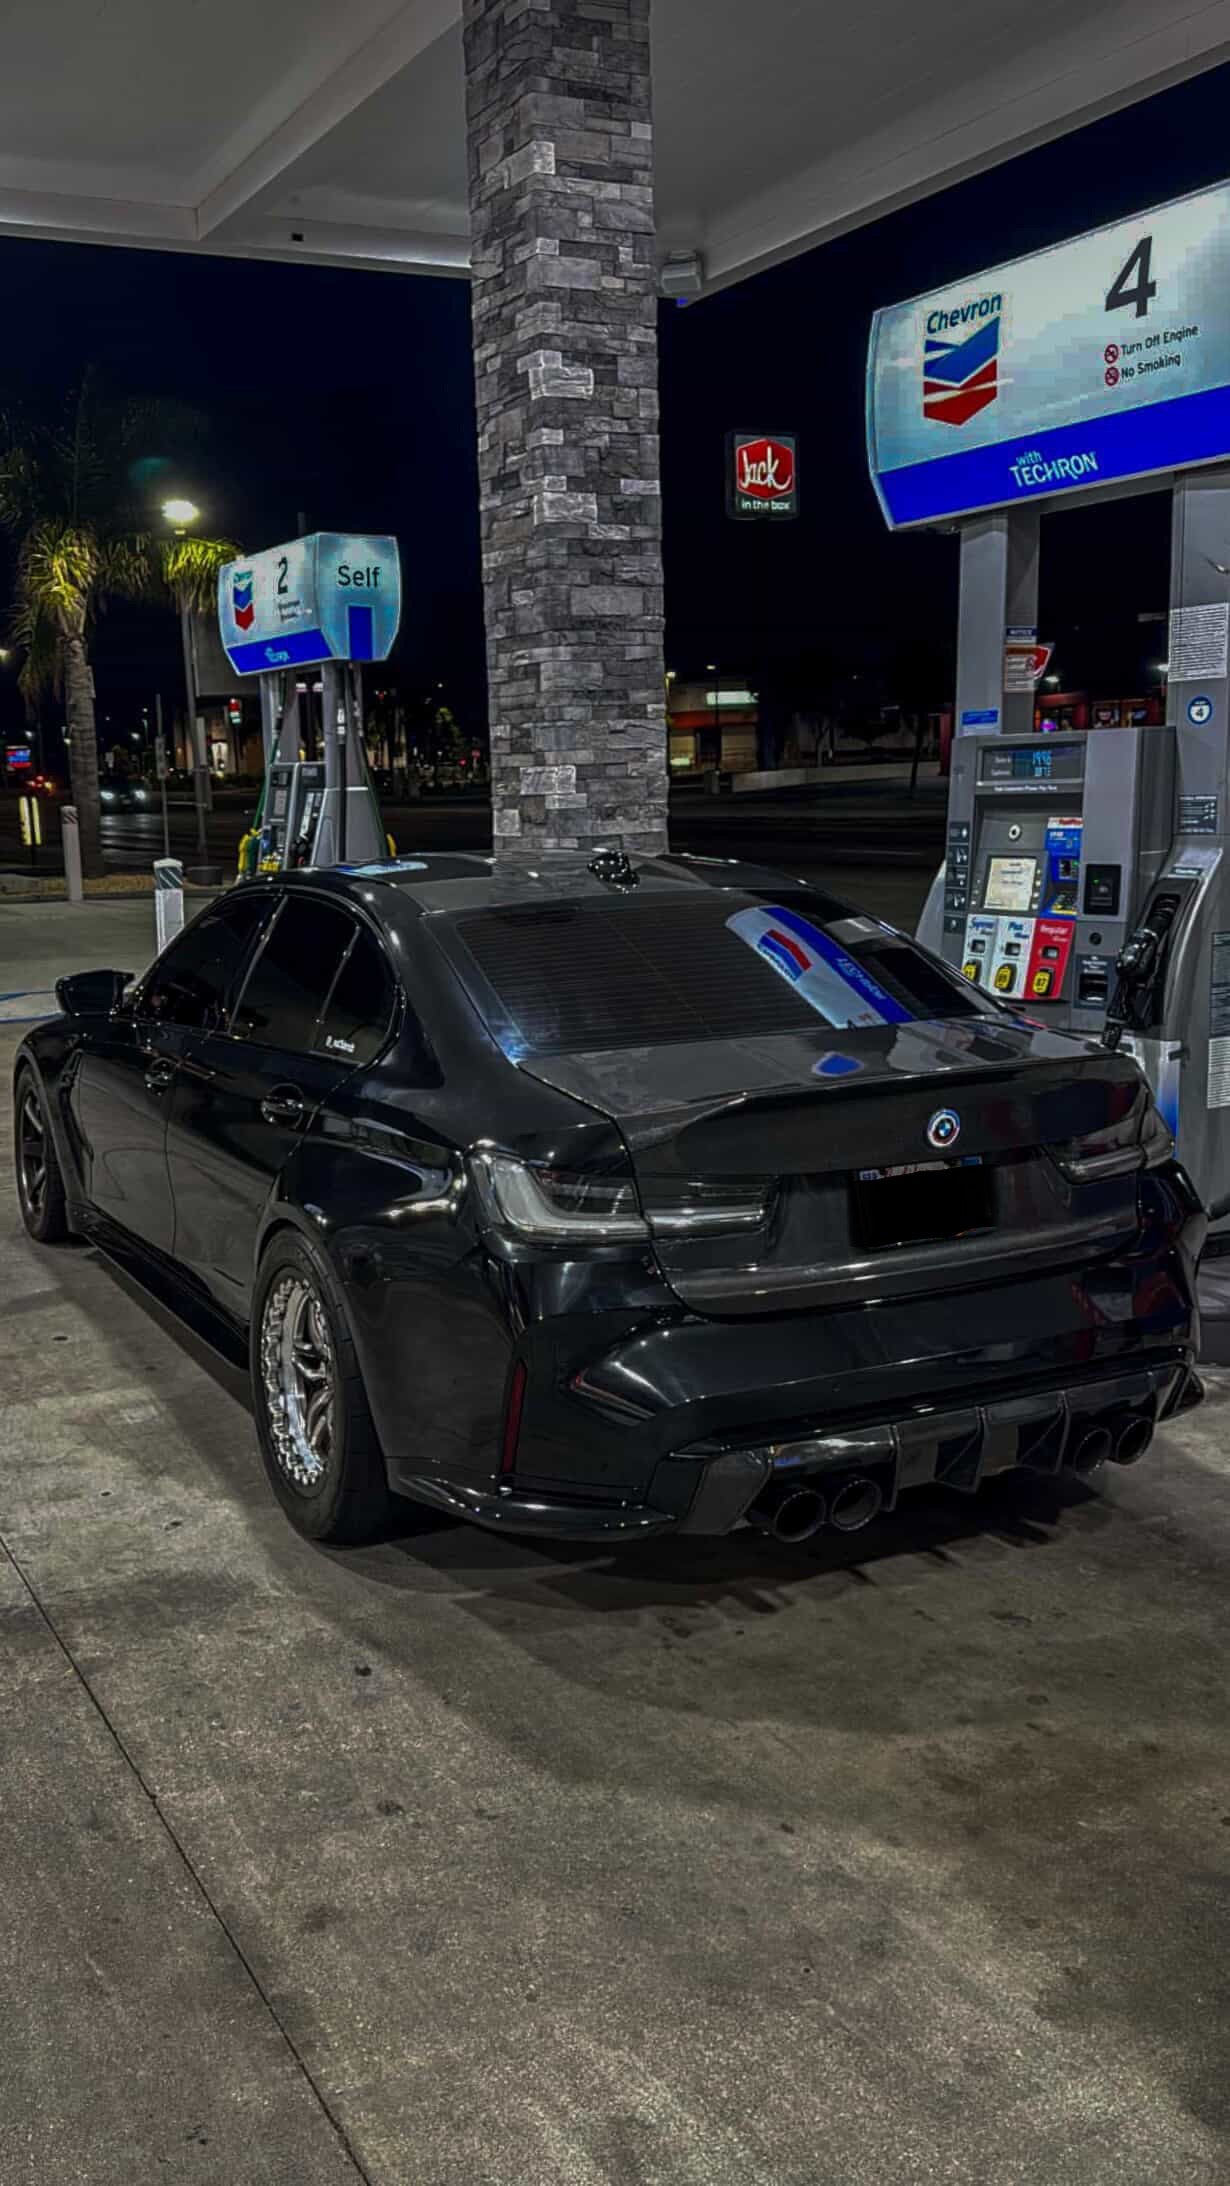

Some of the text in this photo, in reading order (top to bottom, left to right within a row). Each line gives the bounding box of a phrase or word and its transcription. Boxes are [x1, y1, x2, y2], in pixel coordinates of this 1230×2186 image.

[1105, 235, 1157, 318] 4
[926, 294, 1002, 334] Chevron
[1121, 325, 1199, 355] Turn Off Engine
[1121, 353, 1181, 379] No Smoking
[740, 445, 791, 490] Jack
[1009, 452, 1099, 488] TECHRON
[1016, 451, 1042, 466] with
[741, 499, 791, 510] in the box
[277, 556, 289, 594] 2
[337, 564, 382, 588] Self
